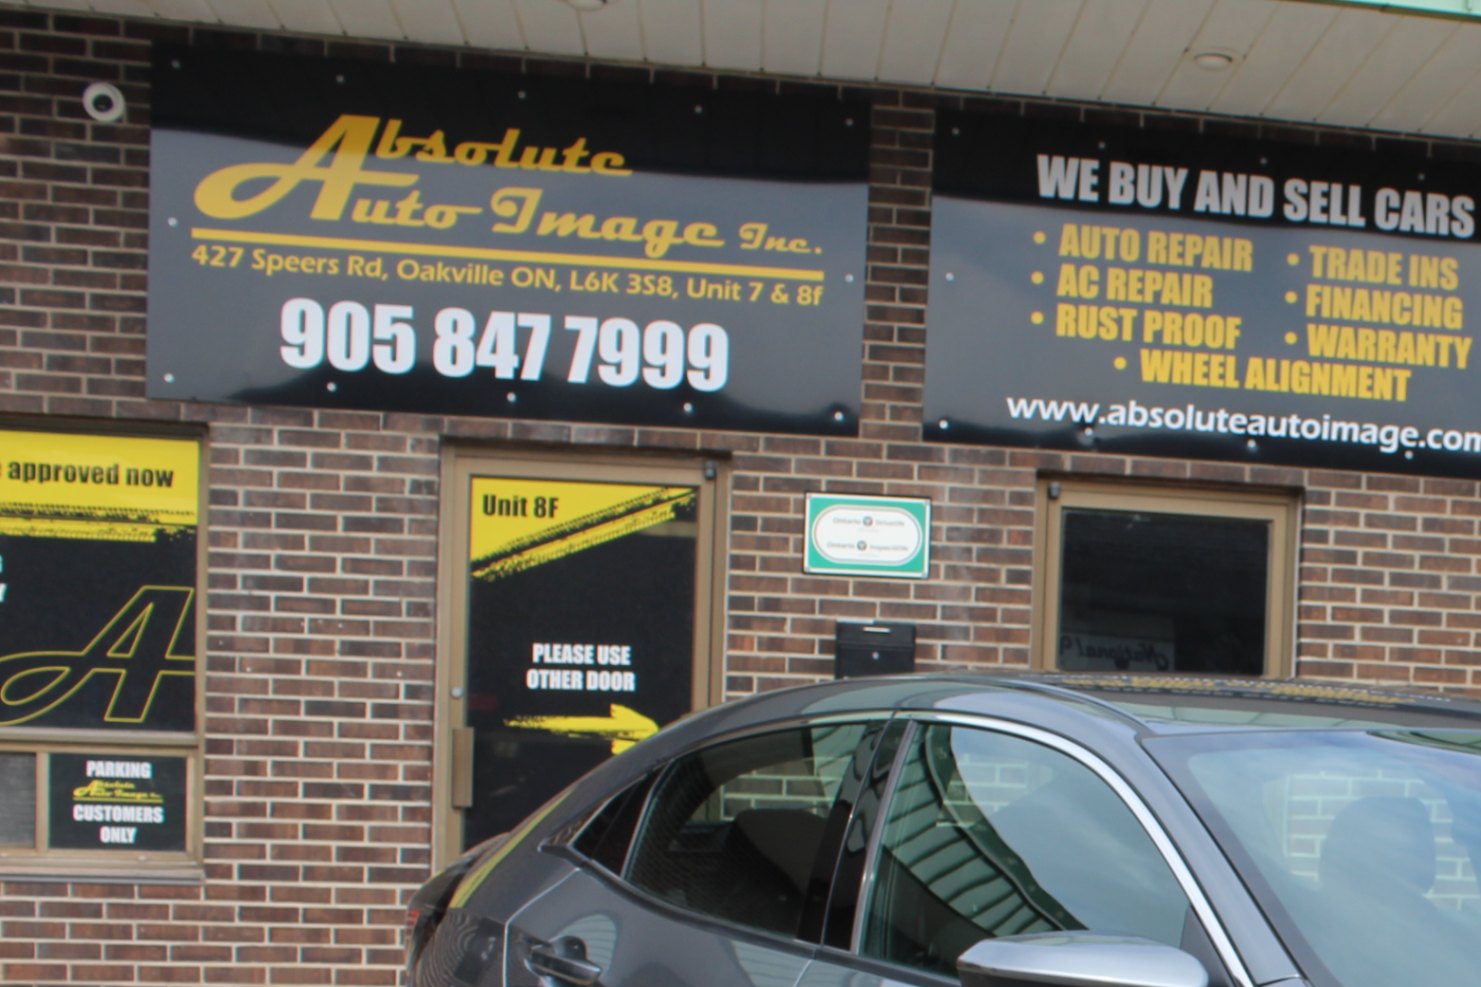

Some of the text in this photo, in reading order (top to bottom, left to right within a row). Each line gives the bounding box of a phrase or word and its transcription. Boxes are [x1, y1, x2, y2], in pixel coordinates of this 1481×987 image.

[1037, 154, 1476, 239] WE BUY AND SELL CARS
[489, 186, 726, 260] Image
[738, 221, 823, 254] Inc.
[1057, 223, 1254, 272] AUTO REPAIR
[1309, 244, 1460, 291] TRADE INS
[191, 244, 825, 307] 427 Speers Rd, Oakville ON, L6K 3S8, Unit 7 & 8f
[1056, 263, 1214, 308] AC REPAIR
[1055, 303, 1243, 349] RUST PROOF
[1305, 284, 1465, 330] FINANCING
[280, 297, 730, 392] 905 847 7999
[1306, 323, 1474, 369] WARRANTY
[1140, 349, 1413, 402] WHEEL ALIGNMENT
[7, 461, 120, 486] approved
[125, 468, 175, 489] now
[482, 494, 560, 520] Unit 8F
[532, 642, 632, 666] PLEASE USE
[525, 668, 636, 692] OTHER DOOR
[86, 760, 153, 779] PARKING
[72, 803, 165, 824] CUSTOMERS
[99, 825, 138, 844] ONLY
